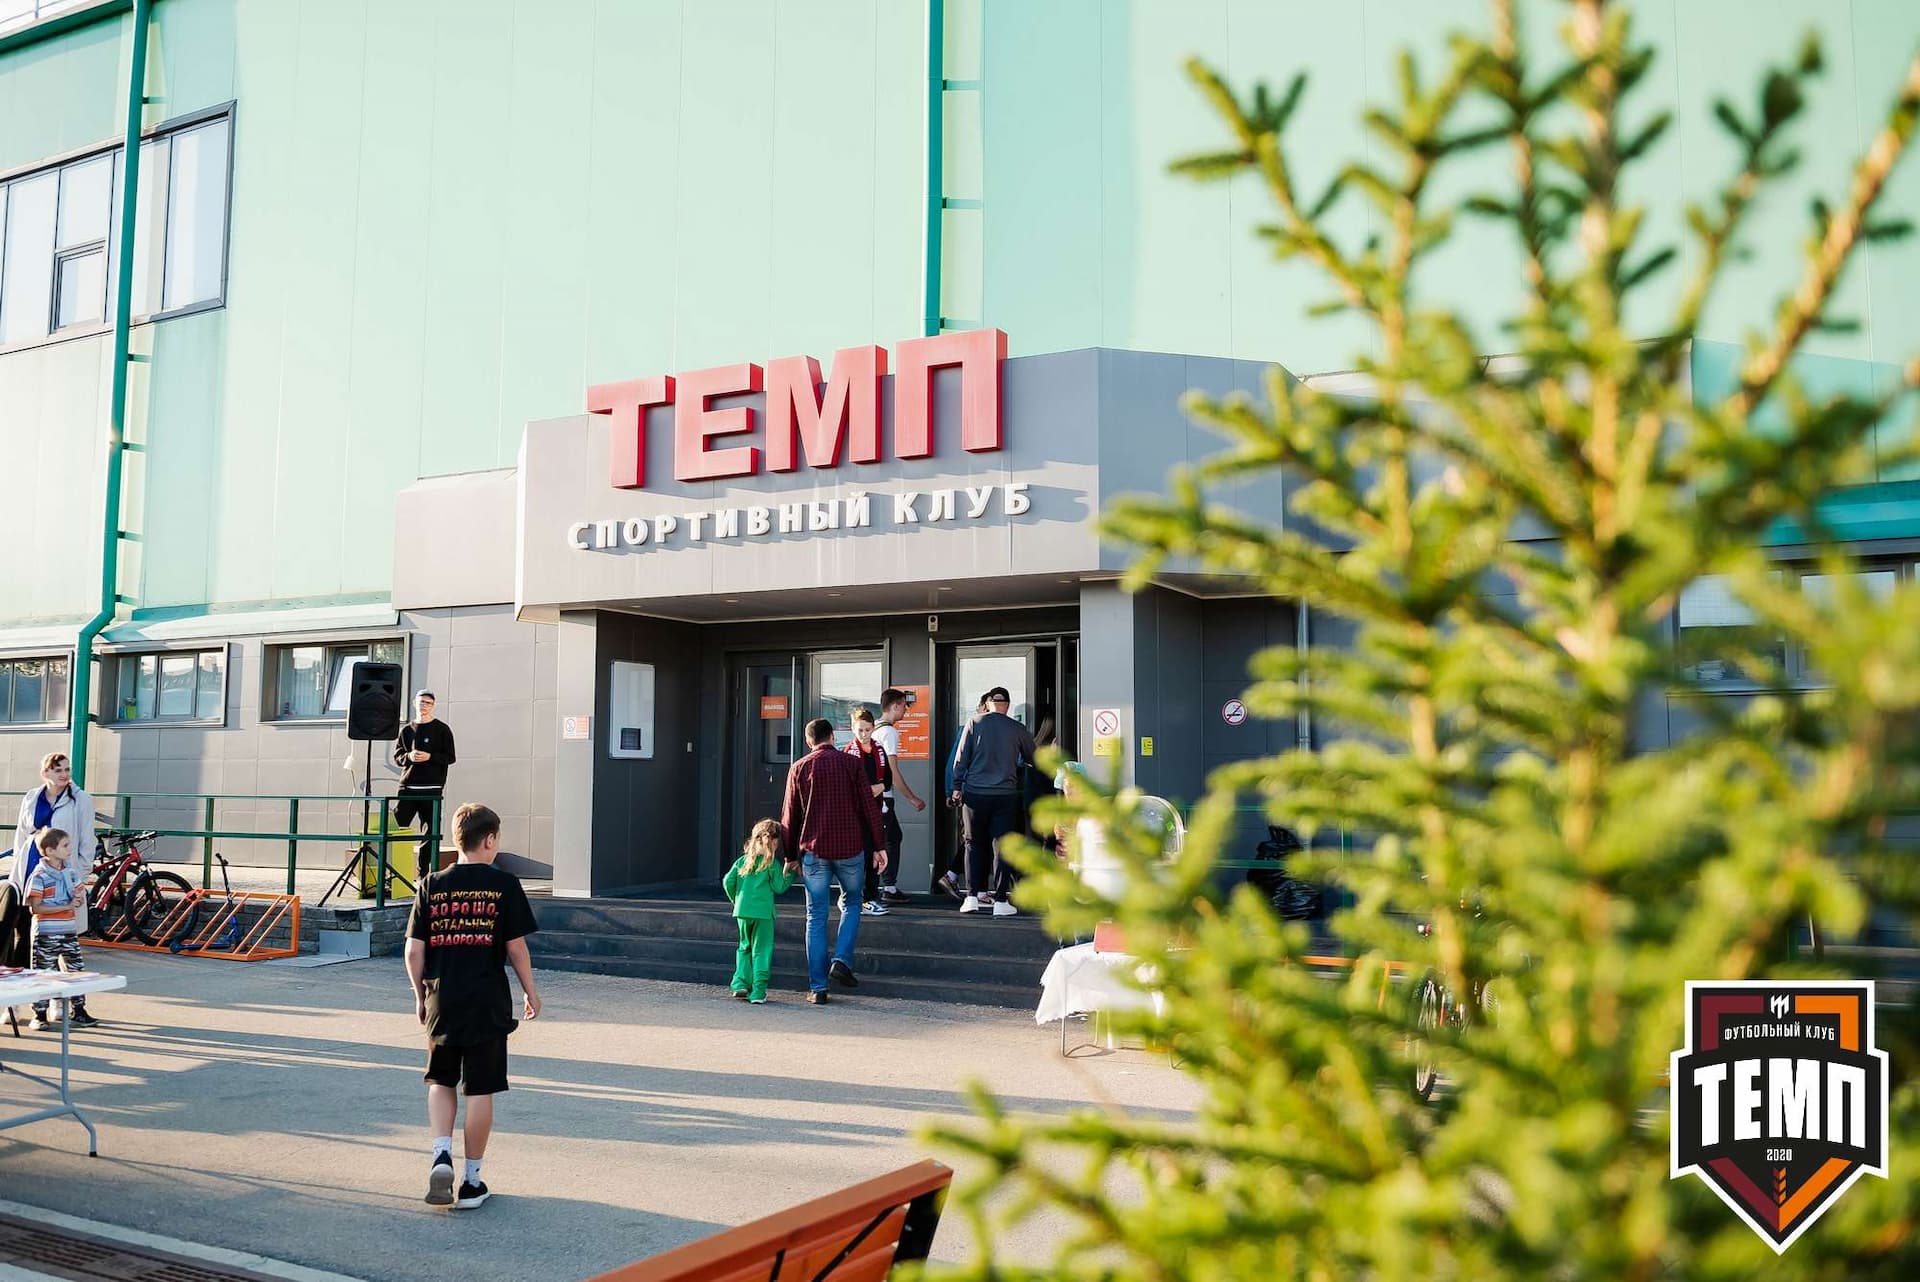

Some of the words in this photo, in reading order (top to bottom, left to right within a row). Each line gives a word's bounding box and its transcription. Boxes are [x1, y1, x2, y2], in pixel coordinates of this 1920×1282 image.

[587, 328, 1008, 489] ТЕМП
[567, 491, 871, 550] СПОРТИВНЫЙ
[894, 482, 1033, 524] КЛУБ
